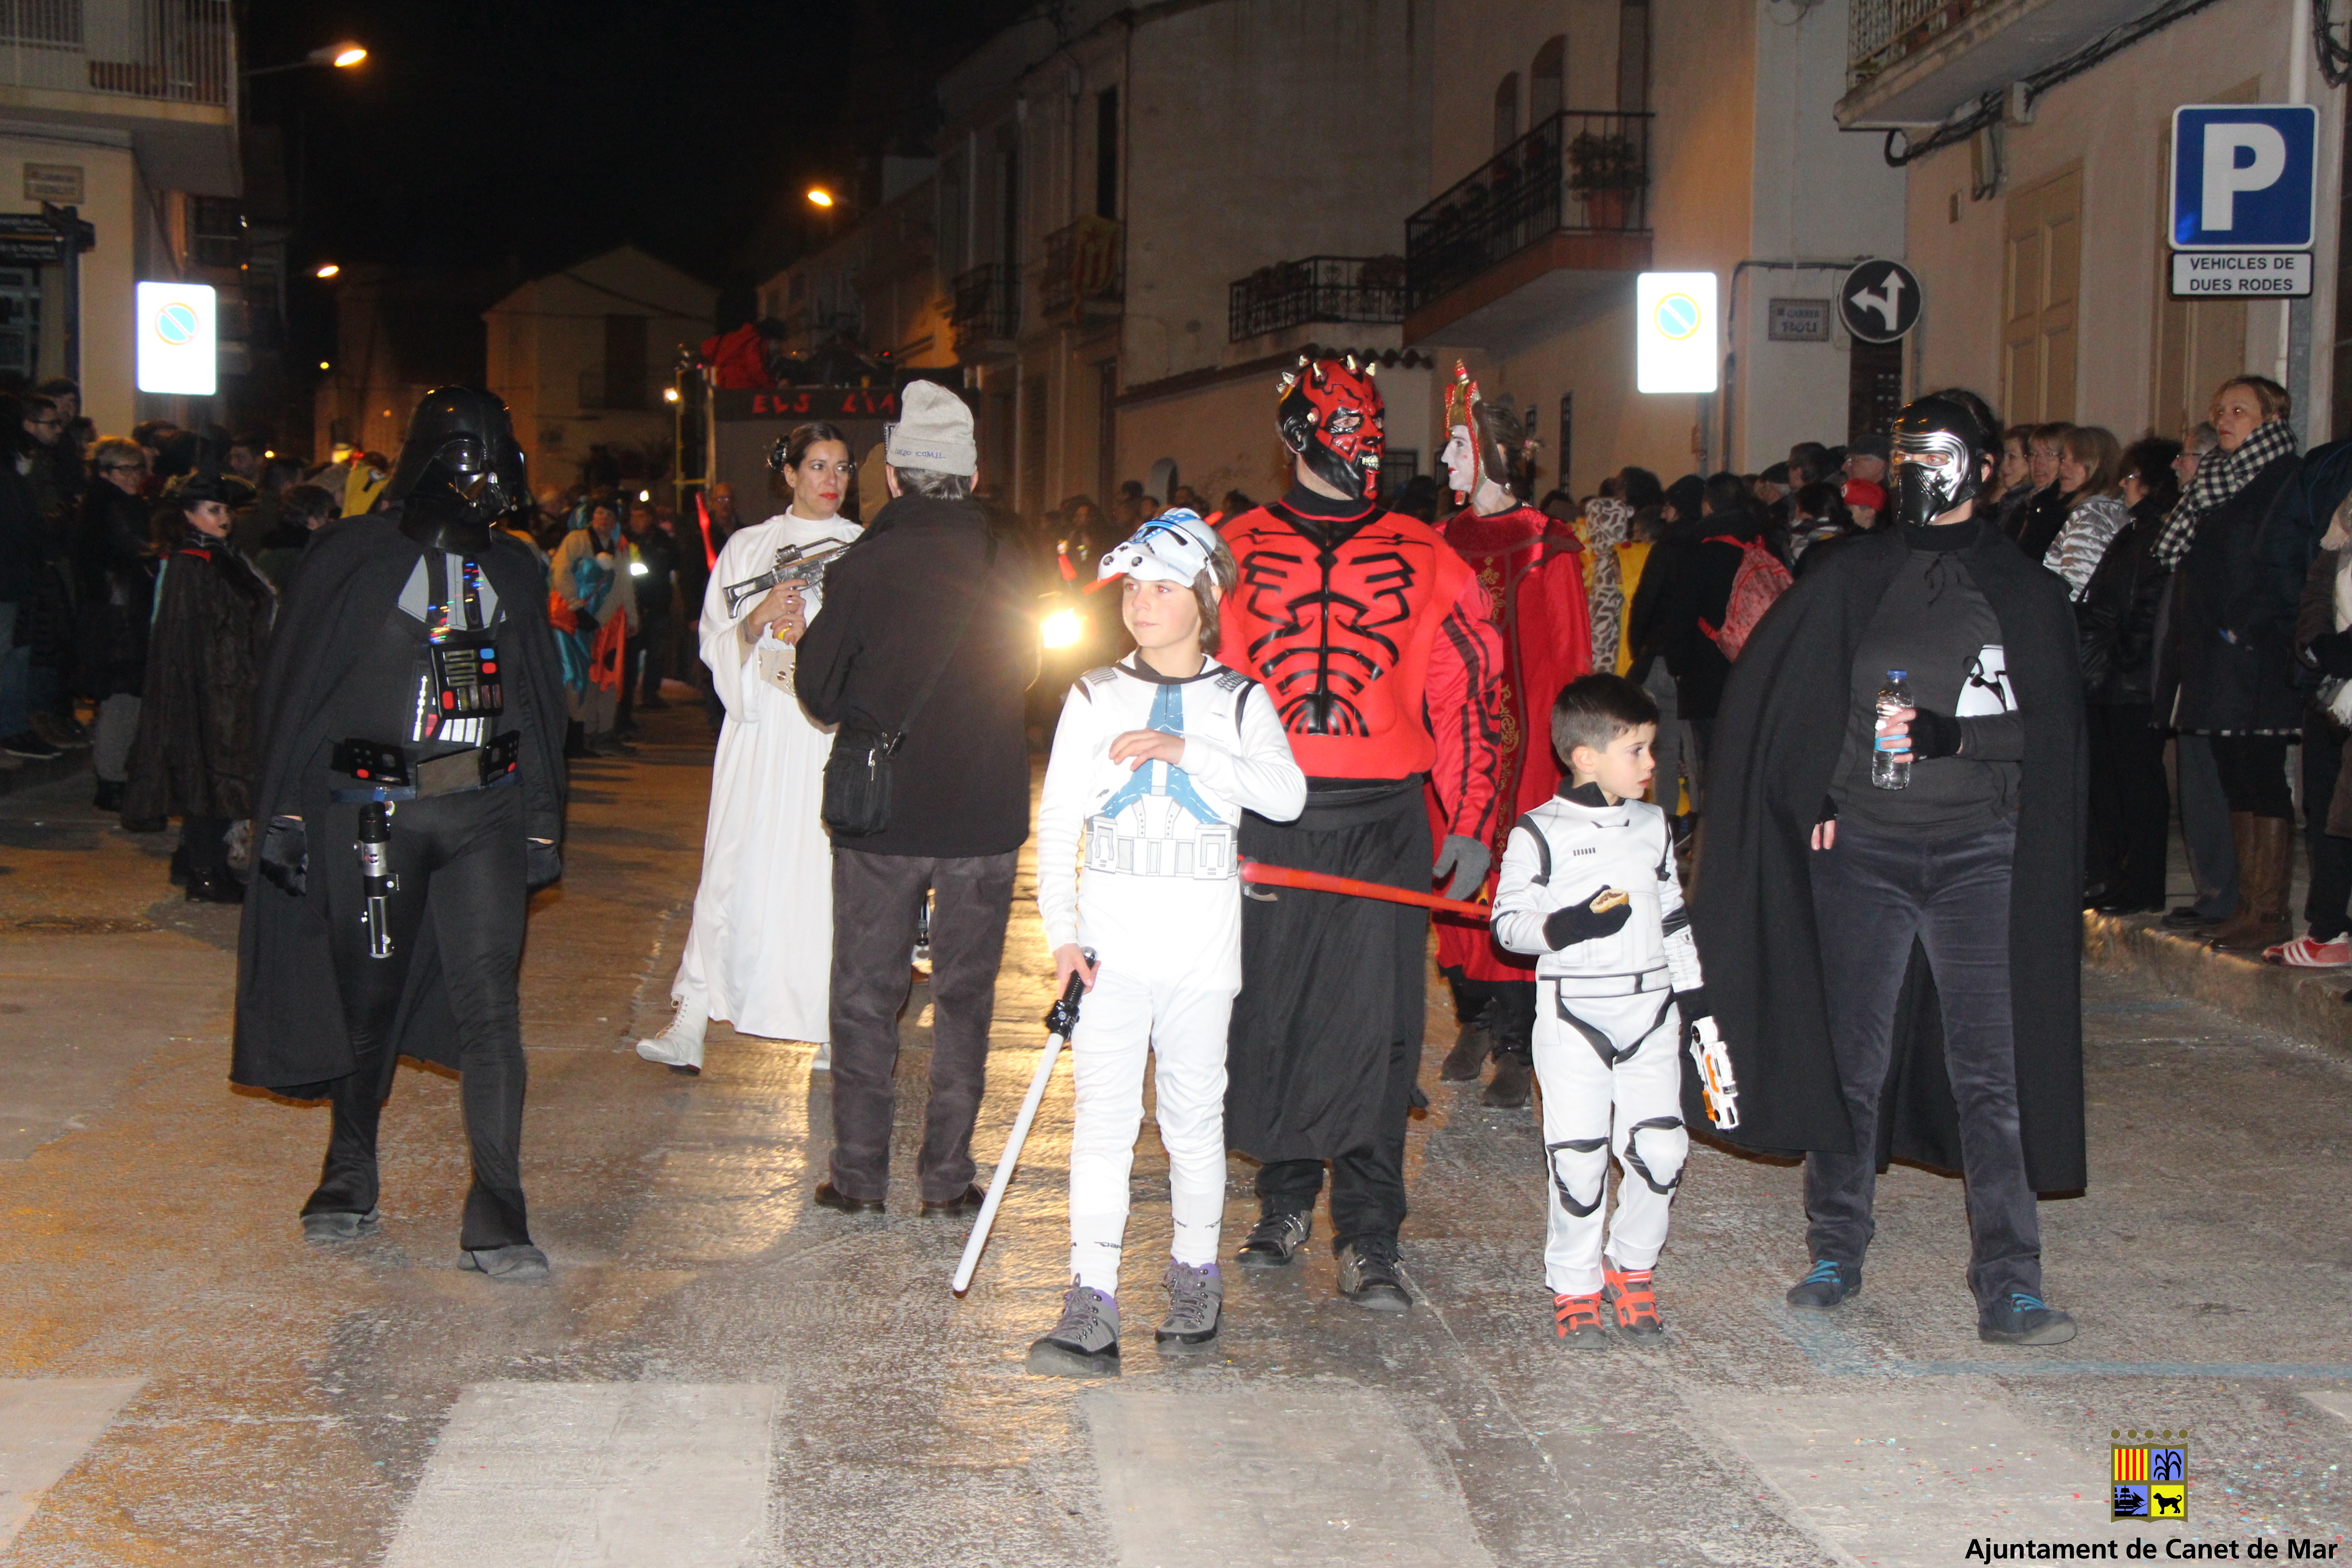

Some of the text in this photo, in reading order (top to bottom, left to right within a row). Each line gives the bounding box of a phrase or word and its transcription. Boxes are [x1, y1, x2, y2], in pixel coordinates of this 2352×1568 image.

[2201, 123, 2286, 231] P
[2190, 257, 2294, 270] VEHICLES DE
[2190, 278, 2293, 291] DUES RODES
[752, 393, 810, 414] ELS
